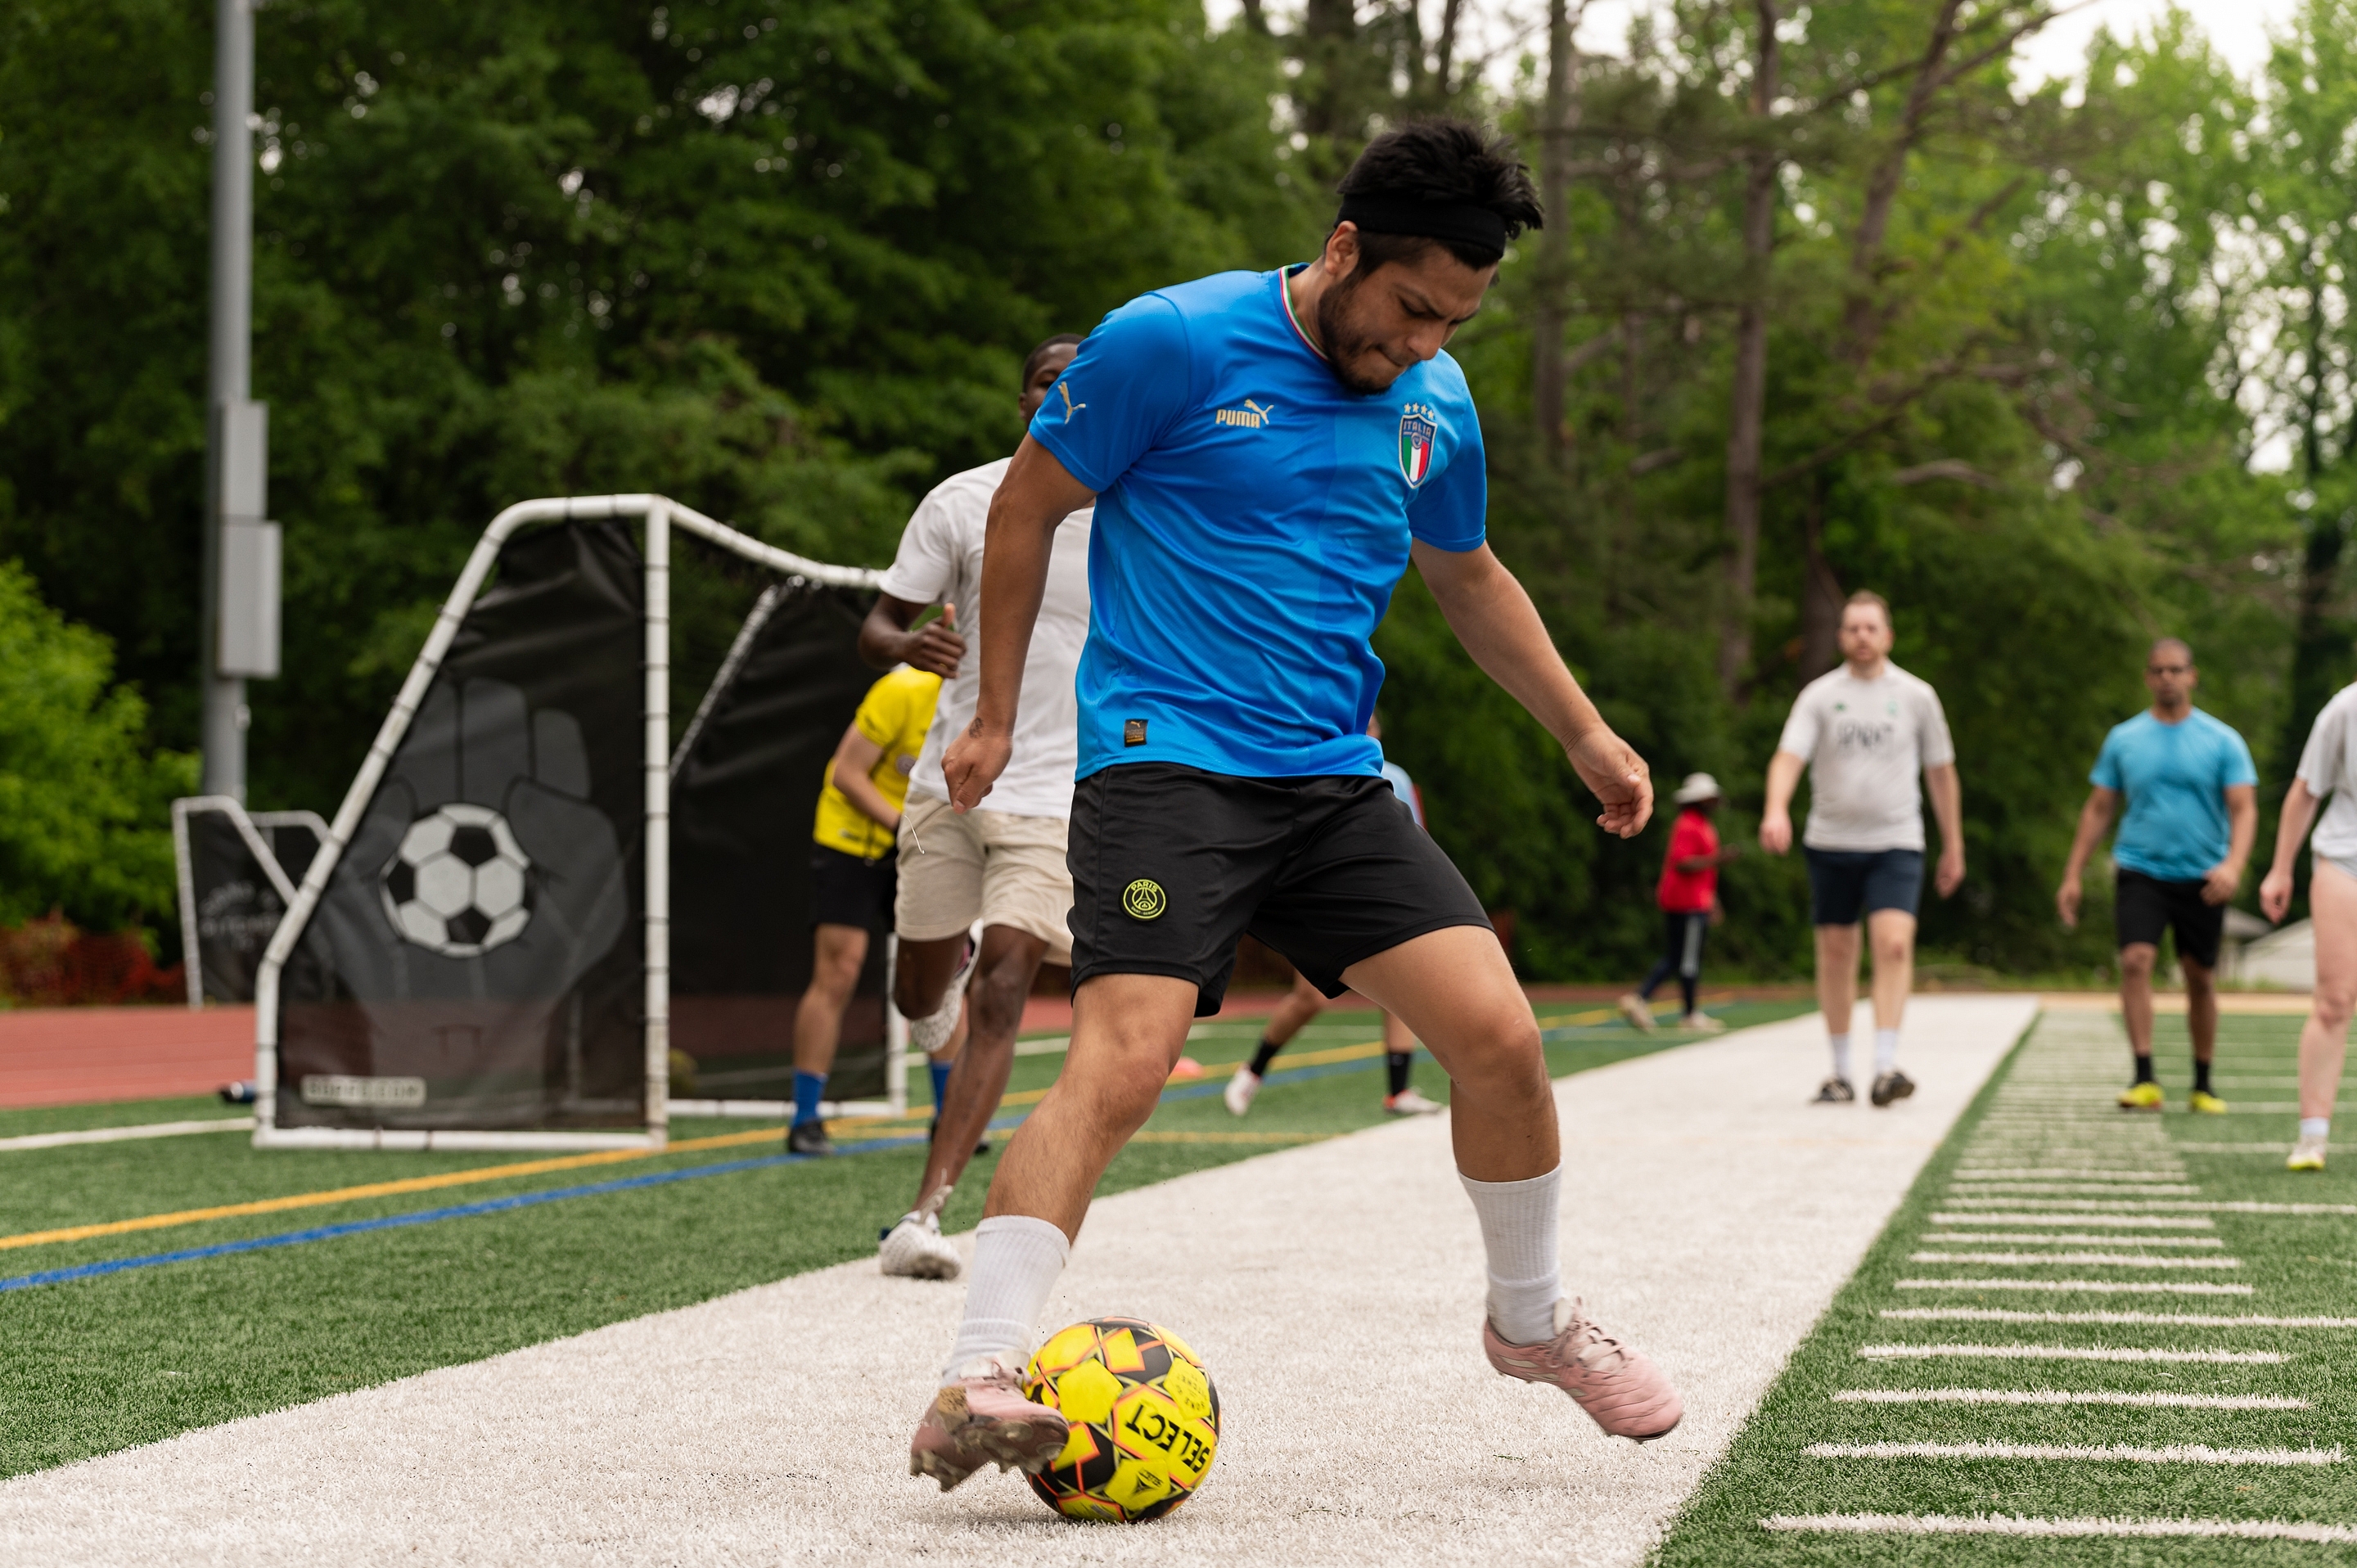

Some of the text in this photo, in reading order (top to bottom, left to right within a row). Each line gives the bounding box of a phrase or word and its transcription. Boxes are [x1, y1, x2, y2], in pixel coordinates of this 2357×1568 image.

[1215, 409, 1260, 429] PUMA
[1403, 421, 1432, 438] ITALIA
[1130, 881, 1159, 892] PARIS
[1125, 1404, 1210, 1474] SELECT
